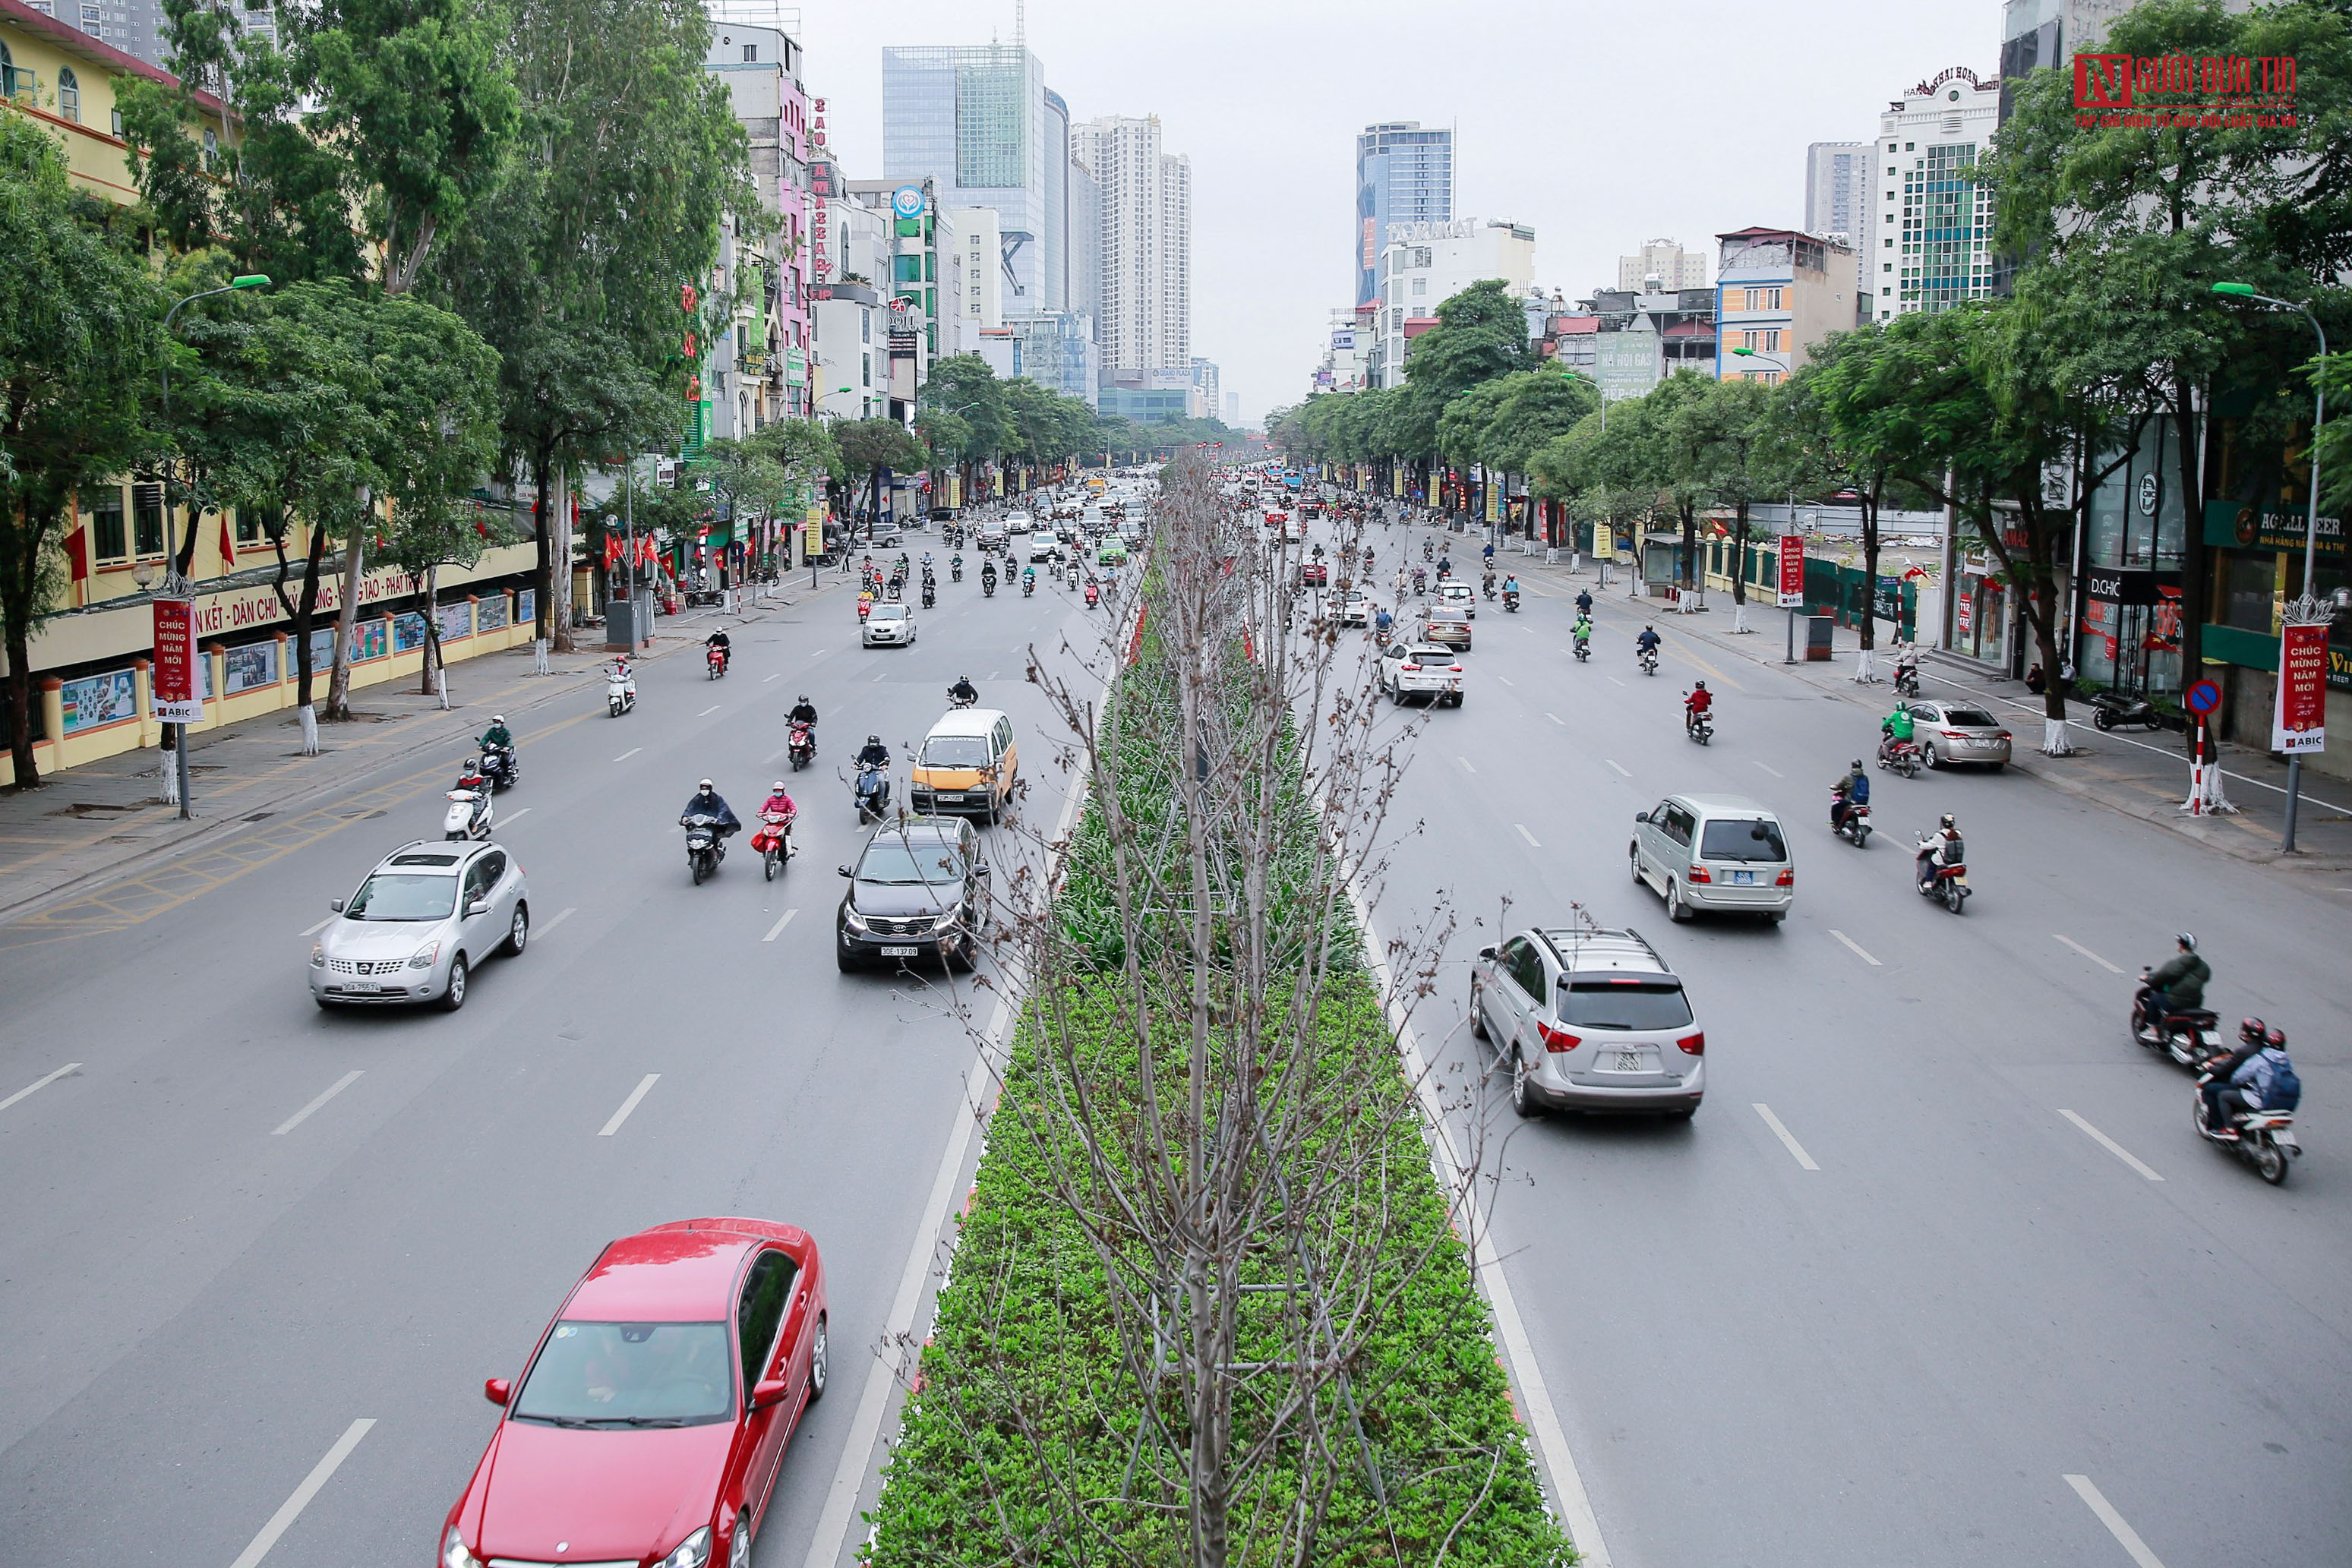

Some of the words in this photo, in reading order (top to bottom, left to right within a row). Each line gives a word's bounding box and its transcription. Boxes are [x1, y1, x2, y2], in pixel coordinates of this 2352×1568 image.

[1635, 352, 1652, 367] GAS
[205, 595, 223, 632] KẾT
[232, 597, 254, 626] DÂN
[257, 588, 278, 620] CHỦ
[365, 579, 380, 602] TẠO
[386, 569, 403, 596] PHÁT
[159, 620, 186, 629] CHÚC
[159, 632, 186, 642] MỪNG
[163, 644, 183, 653] NĂM
[2290, 645, 2322, 656] CHÚC
[164, 655, 182, 664] MỚI
[2290, 658, 2322, 668] MỪNG
[2294, 670, 2316, 680] NĂM
[2332, 674, 2350, 684] BEER
[168, 708, 191, 717] ABIC
[2297, 736, 2322, 746] ABIC
